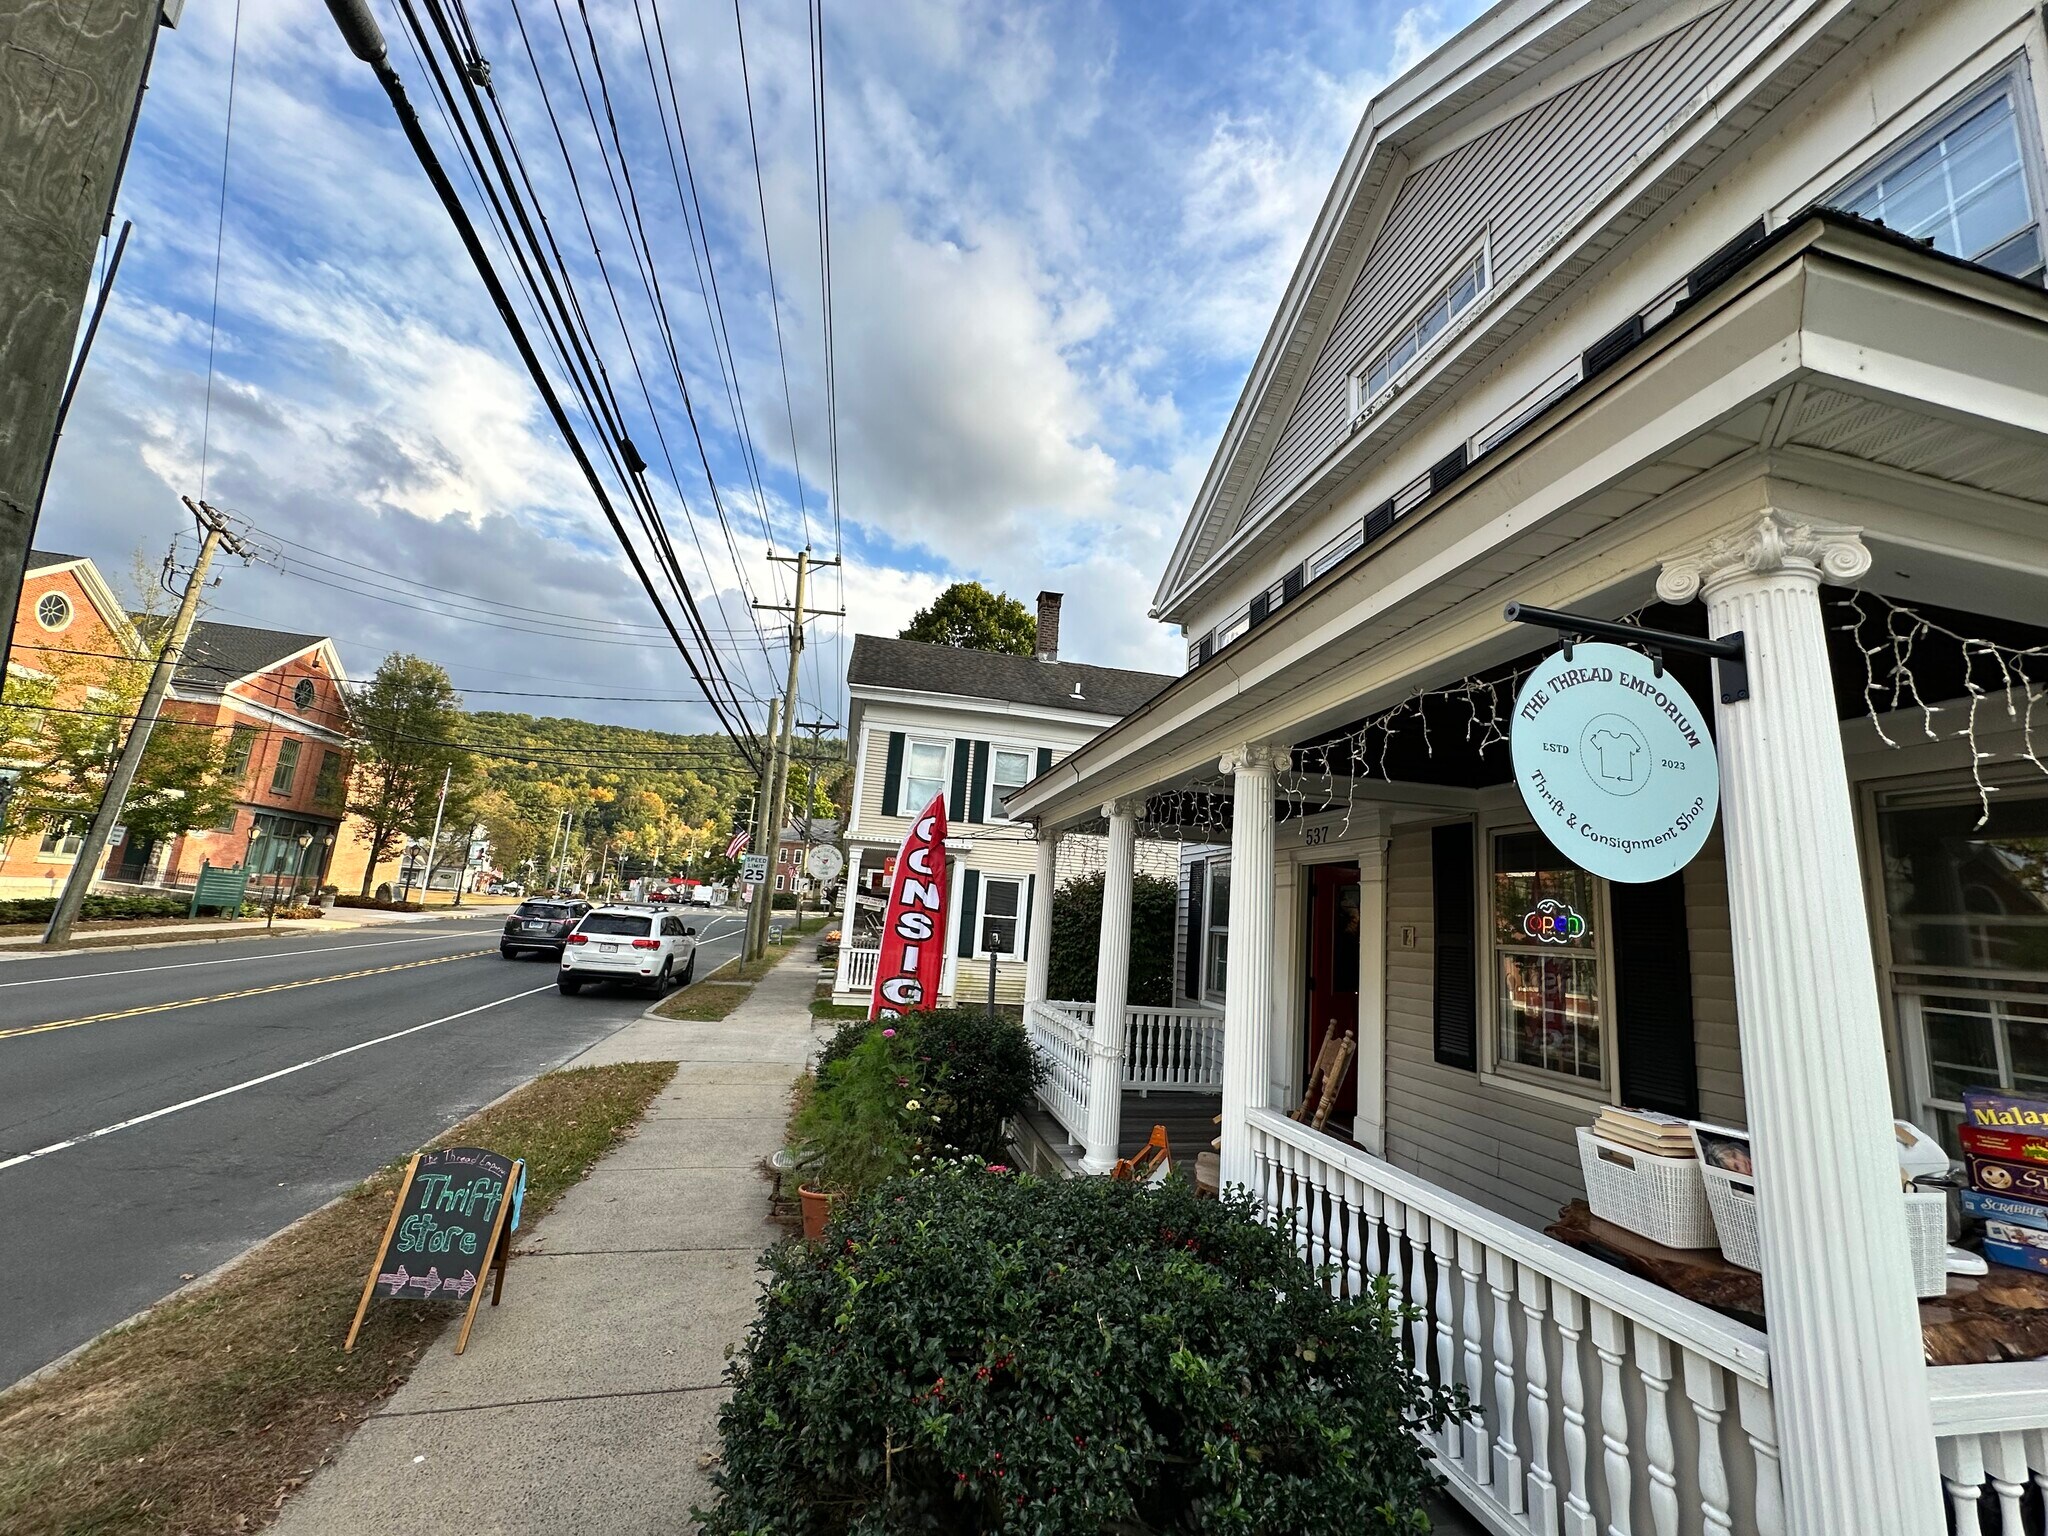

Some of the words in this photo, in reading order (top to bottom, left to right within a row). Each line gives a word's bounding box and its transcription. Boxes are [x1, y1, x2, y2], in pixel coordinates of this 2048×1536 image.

[1520, 689, 1550, 722] THE
[1547, 667, 1613, 695] THREAD
[1619, 672, 1703, 750] EMPORIUM
[1542, 742, 1570, 755] ESTD
[1661, 759, 1686, 771] 2023
[1531, 769, 1566, 817] Thrift
[1566, 813, 1578, 829] &
[1580, 823, 1678, 853] Consignment
[1675, 796, 1705, 831] Shop
[1306, 826, 1329, 846] 537
[744, 869, 765, 881] 25
[443, 1149, 481, 1165] Thread
[416, 1173, 503, 1222] Thrift
[1980, 1198, 2045, 1217] SCRABBLE
[396, 1213, 478, 1255] Store
